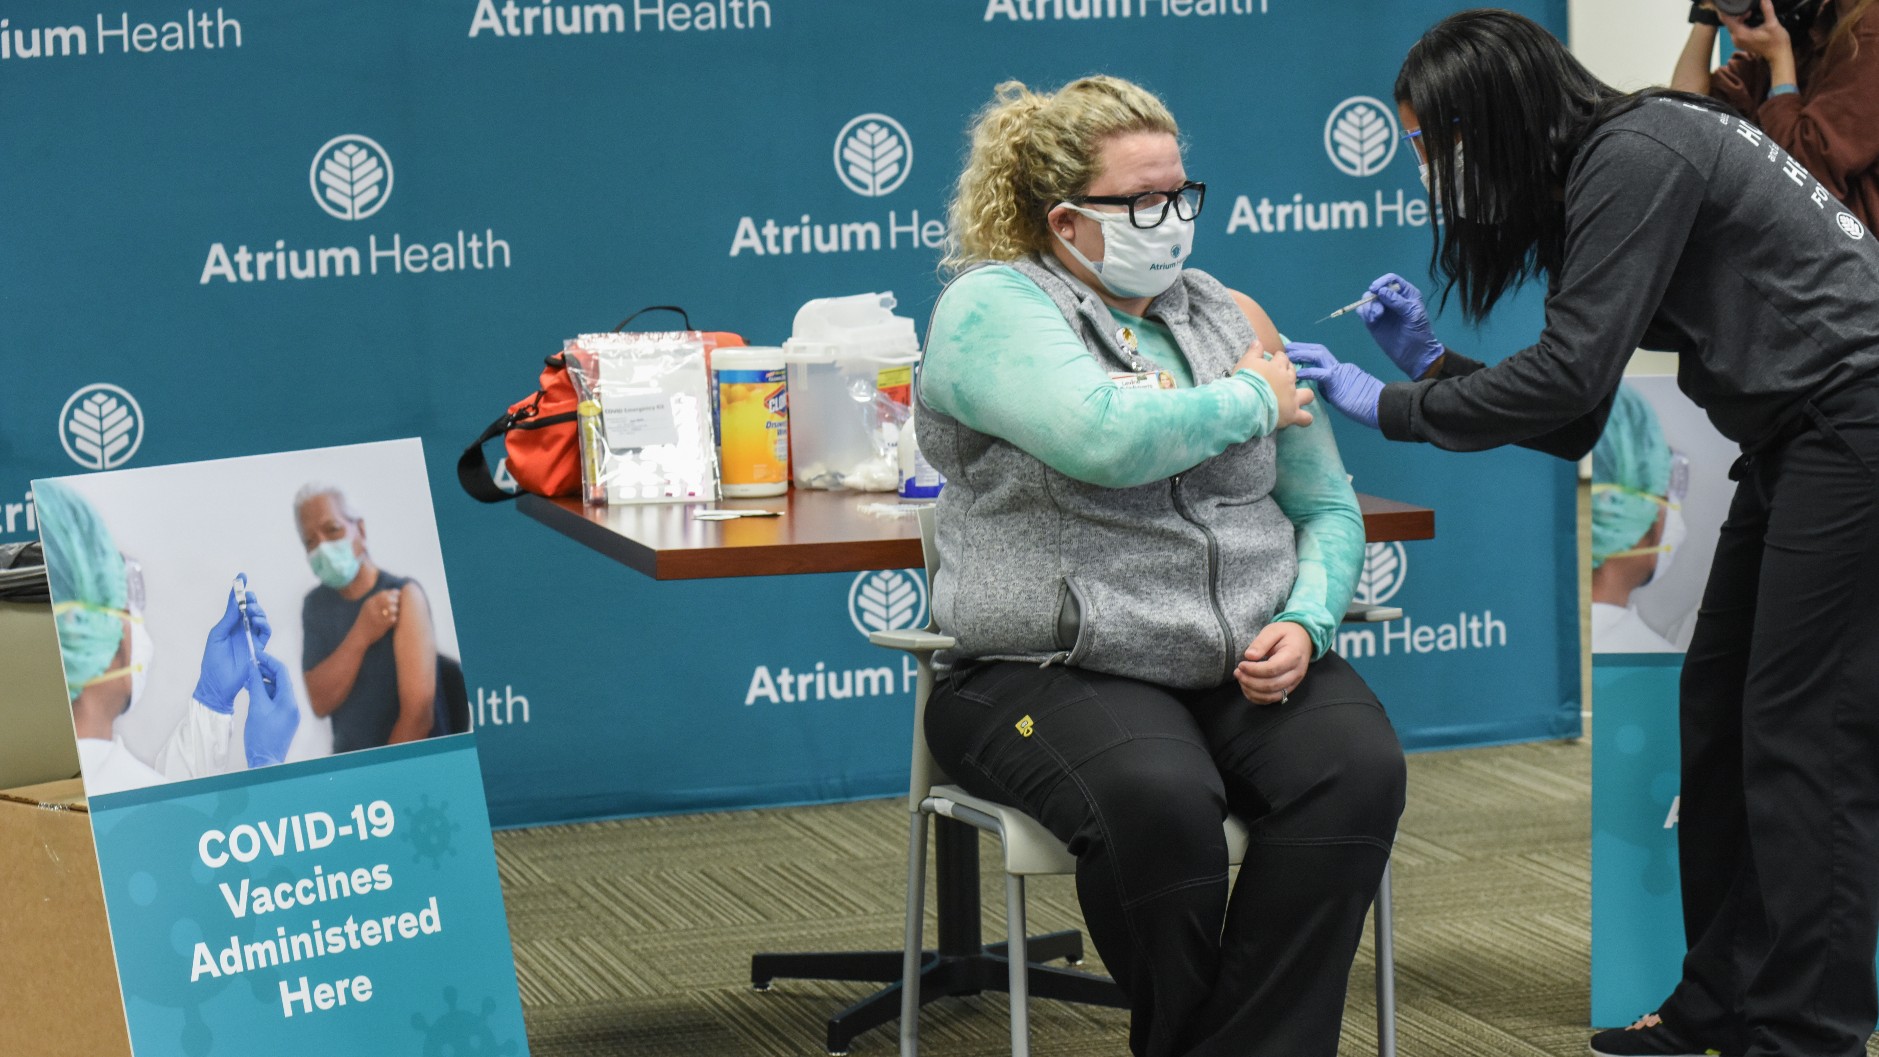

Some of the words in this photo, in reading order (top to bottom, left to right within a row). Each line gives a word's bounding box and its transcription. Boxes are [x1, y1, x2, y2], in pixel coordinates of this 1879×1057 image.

[97, 9, 242, 54] Health
[468, 0, 624, 37] Atrium
[634, 0, 771, 32] Health
[729, 214, 880, 257] Atrium
[1226, 193, 1368, 234] Atrium
[200, 240, 360, 284] Atrium
[369, 229, 511, 274] Health
[1149, 261, 1176, 271] Atrium
[0, 490, 36, 533] ri
[1383, 611, 1507, 656] Health
[469, 684, 530, 727] lth
[744, 662, 894, 706] Atrium
[198, 800, 396, 868] COVID-19
[219, 863, 393, 919] Vaccines
[190, 896, 442, 983] Administered
[279, 974, 373, 1018] Here
